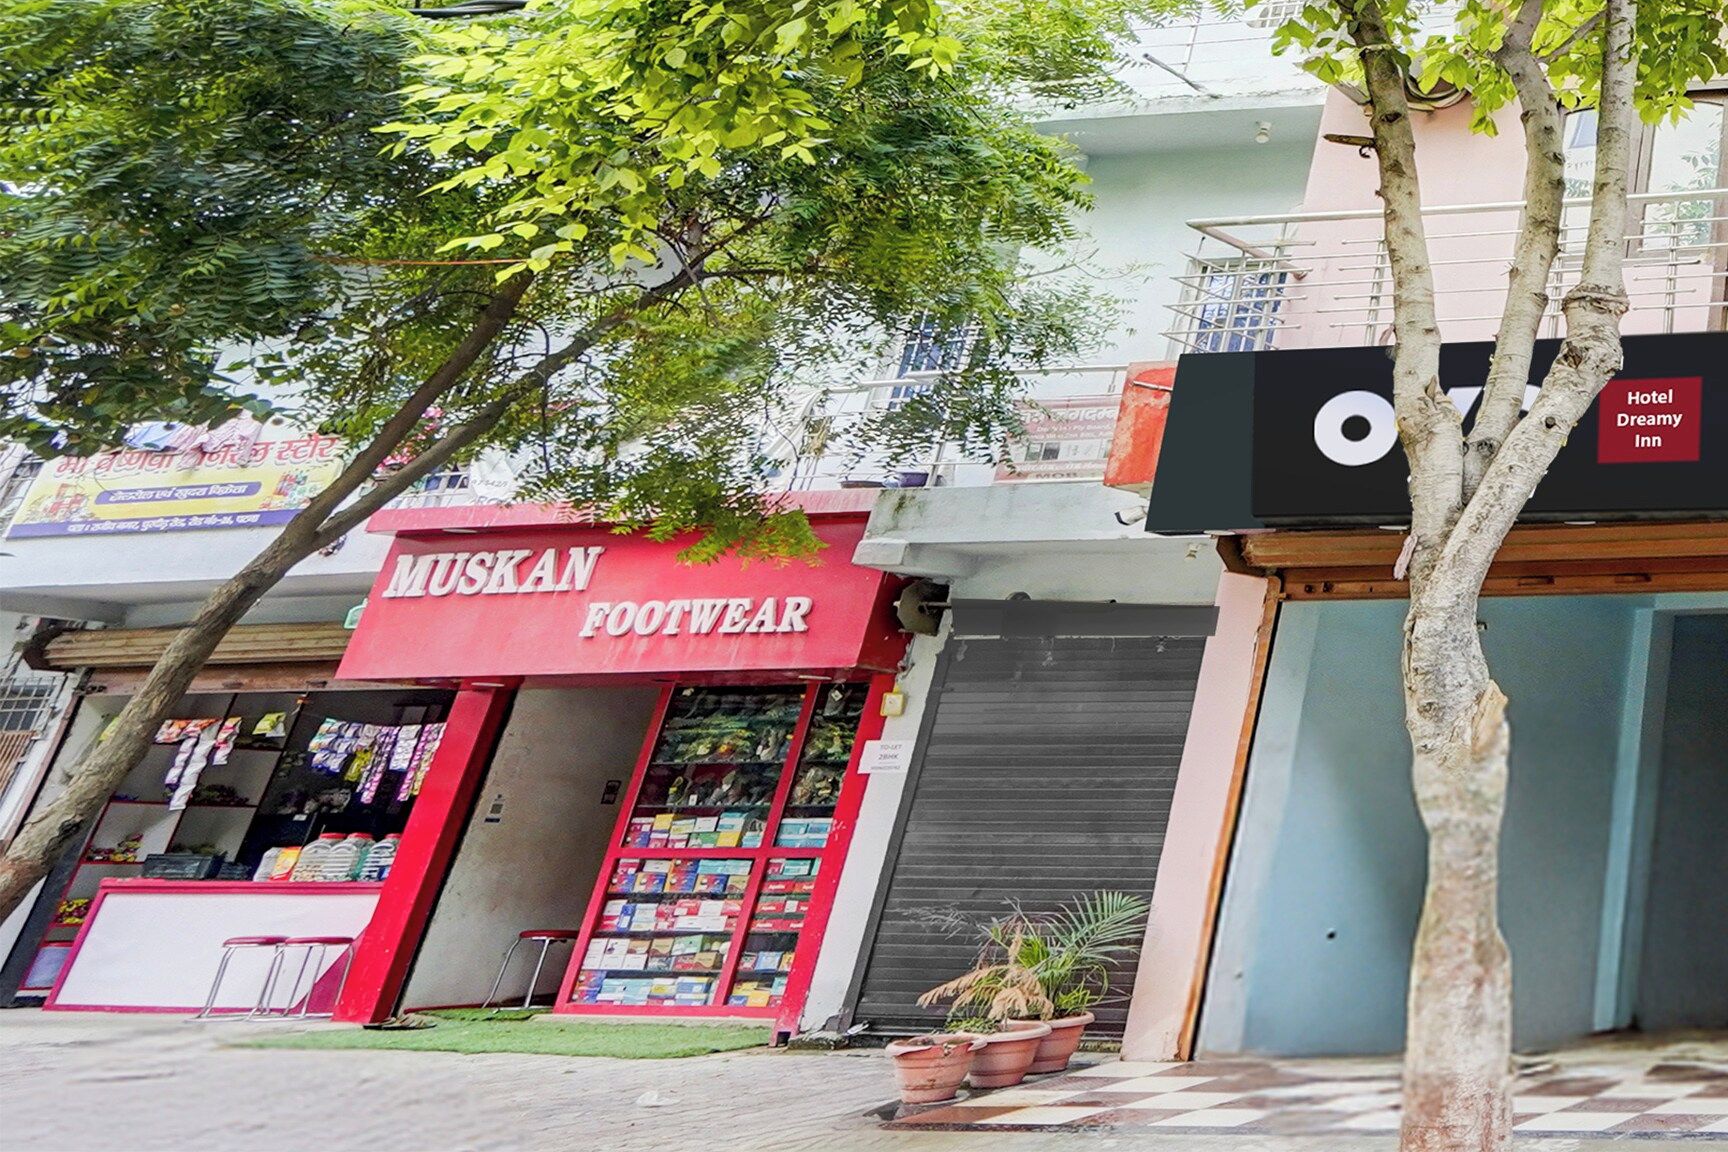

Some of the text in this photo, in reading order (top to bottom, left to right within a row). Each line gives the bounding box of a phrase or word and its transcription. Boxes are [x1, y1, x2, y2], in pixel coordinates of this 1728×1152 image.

[1627, 389, 1673, 405] Hotel
[1617, 413, 1683, 428] Dreamy
[1635, 434, 1662, 448] Inn
[382, 546, 604, 599] MUSKAN
[578, 596, 812, 639] FOOTWEAR
